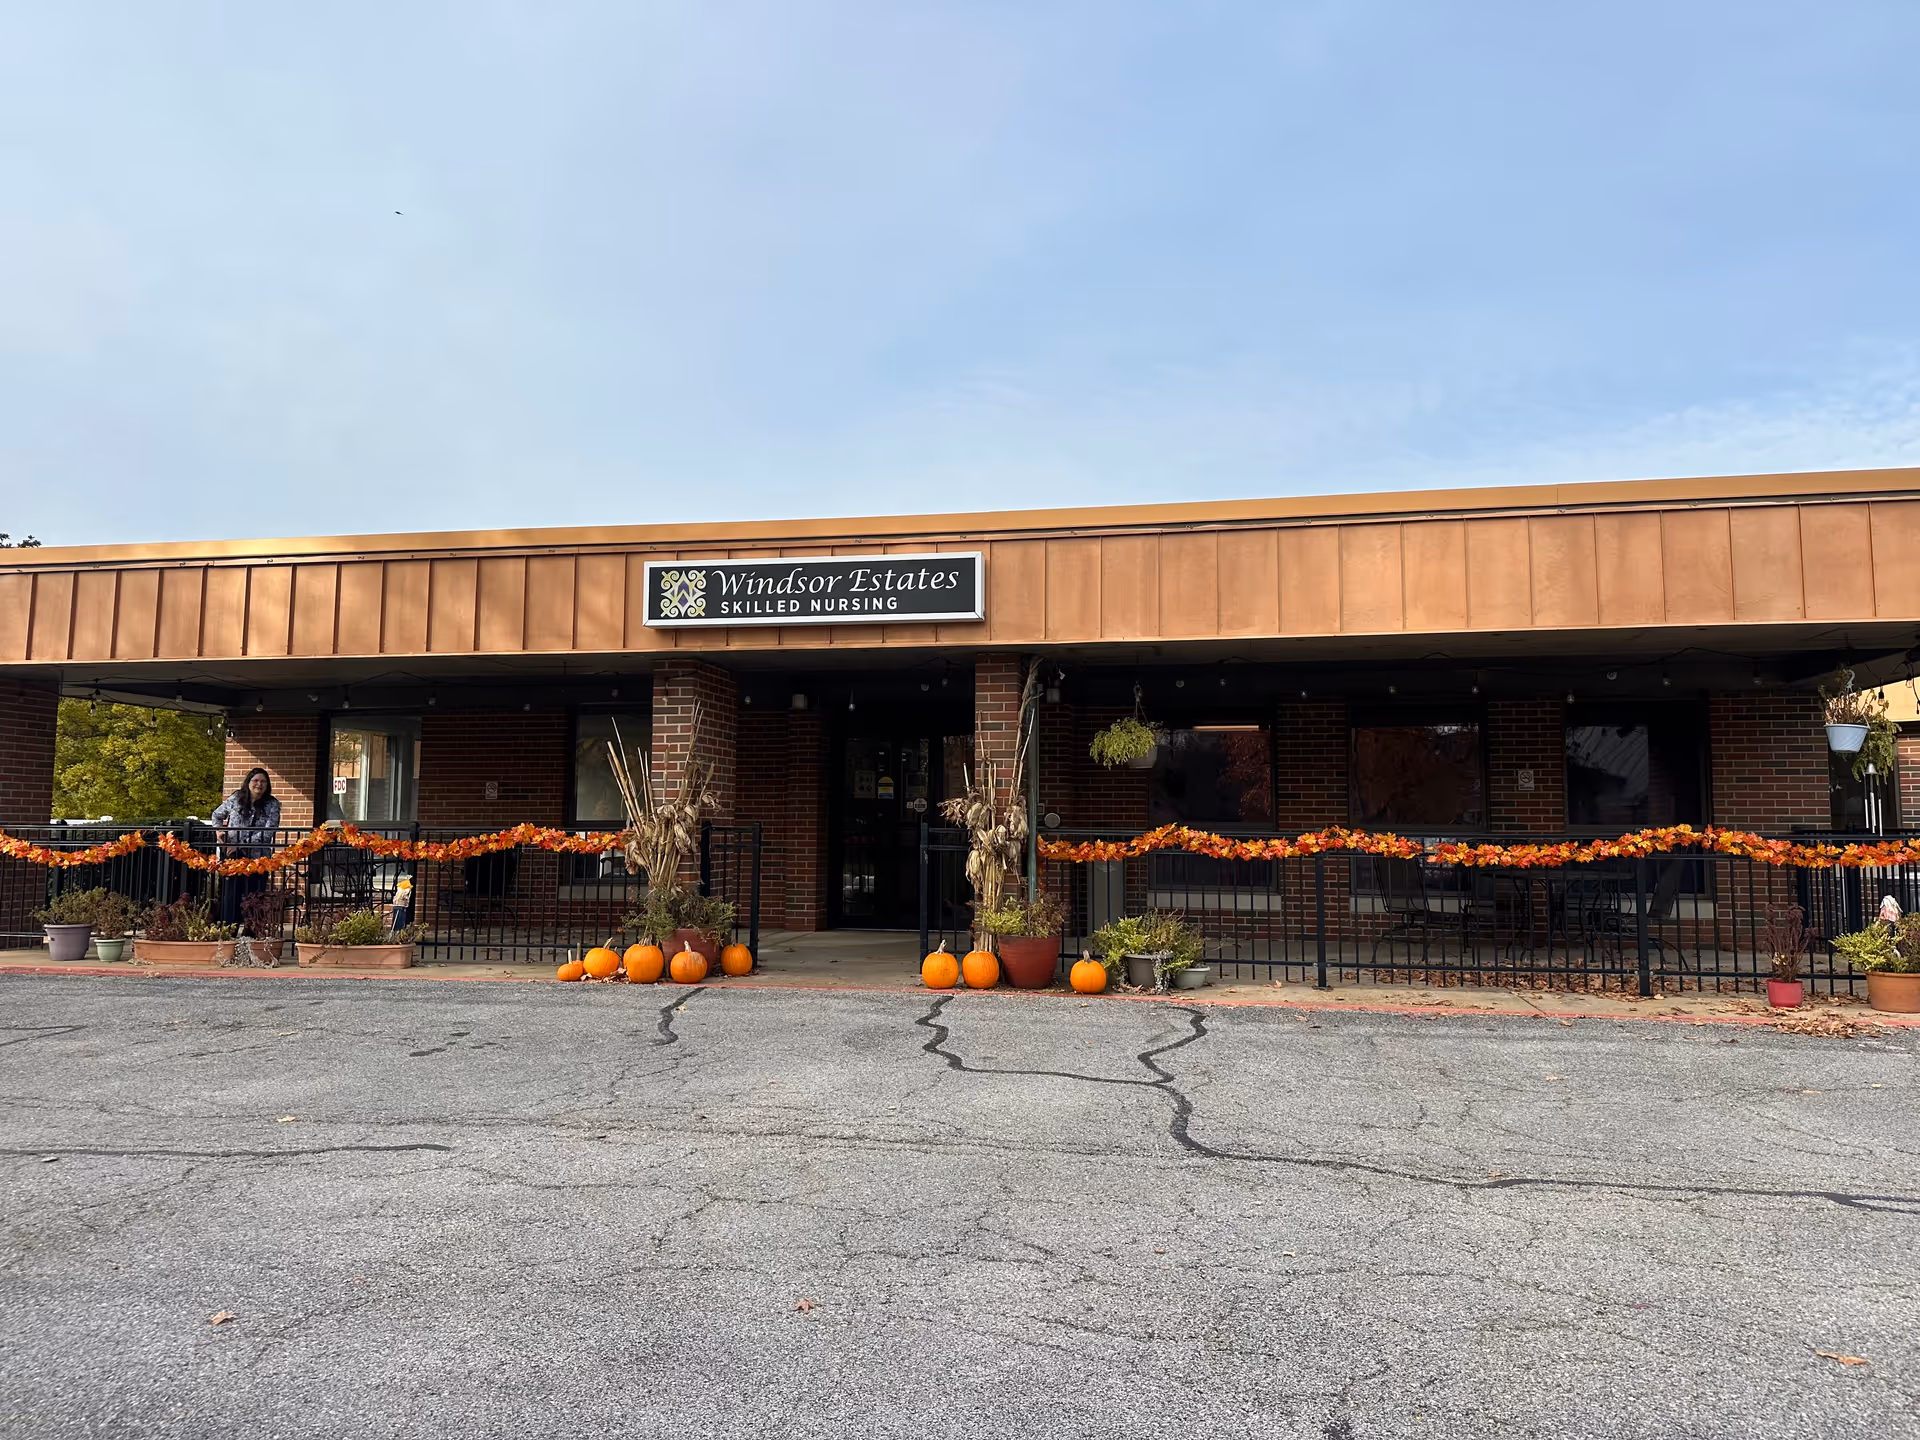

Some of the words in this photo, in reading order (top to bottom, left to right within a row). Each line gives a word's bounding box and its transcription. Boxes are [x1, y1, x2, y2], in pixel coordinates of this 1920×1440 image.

[711, 568, 843, 596] Windsor
[849, 568, 959, 592] Estates
[720, 600, 800, 614] SKILLED
[810, 597, 898, 612] NURSING
